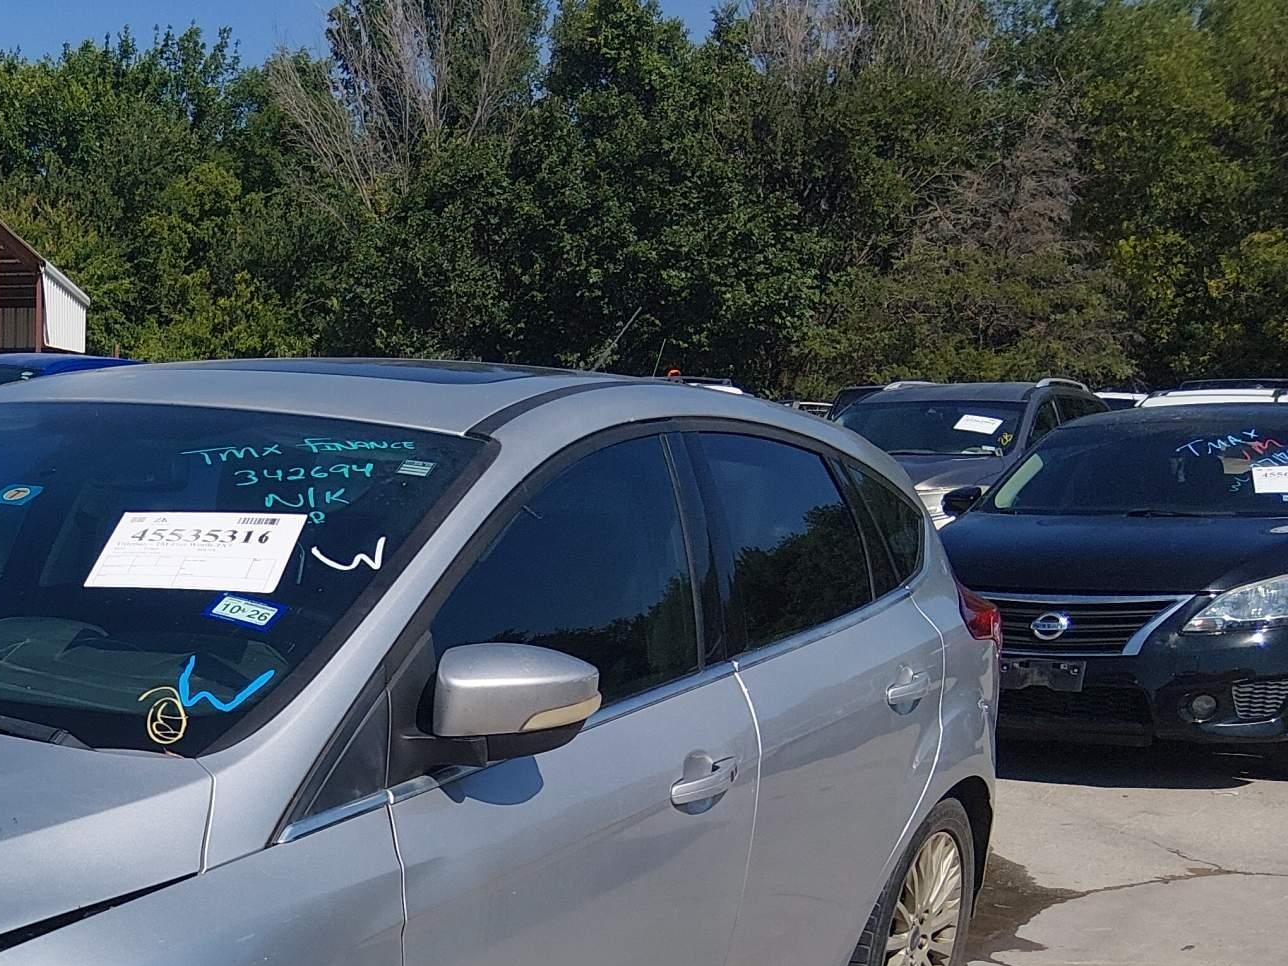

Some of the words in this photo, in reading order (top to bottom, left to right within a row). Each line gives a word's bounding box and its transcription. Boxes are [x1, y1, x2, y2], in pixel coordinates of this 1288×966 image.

[296, 437, 416, 453] FINANCE
[234, 462, 374, 486] 342694
[130, 528, 272, 545] 45535316
